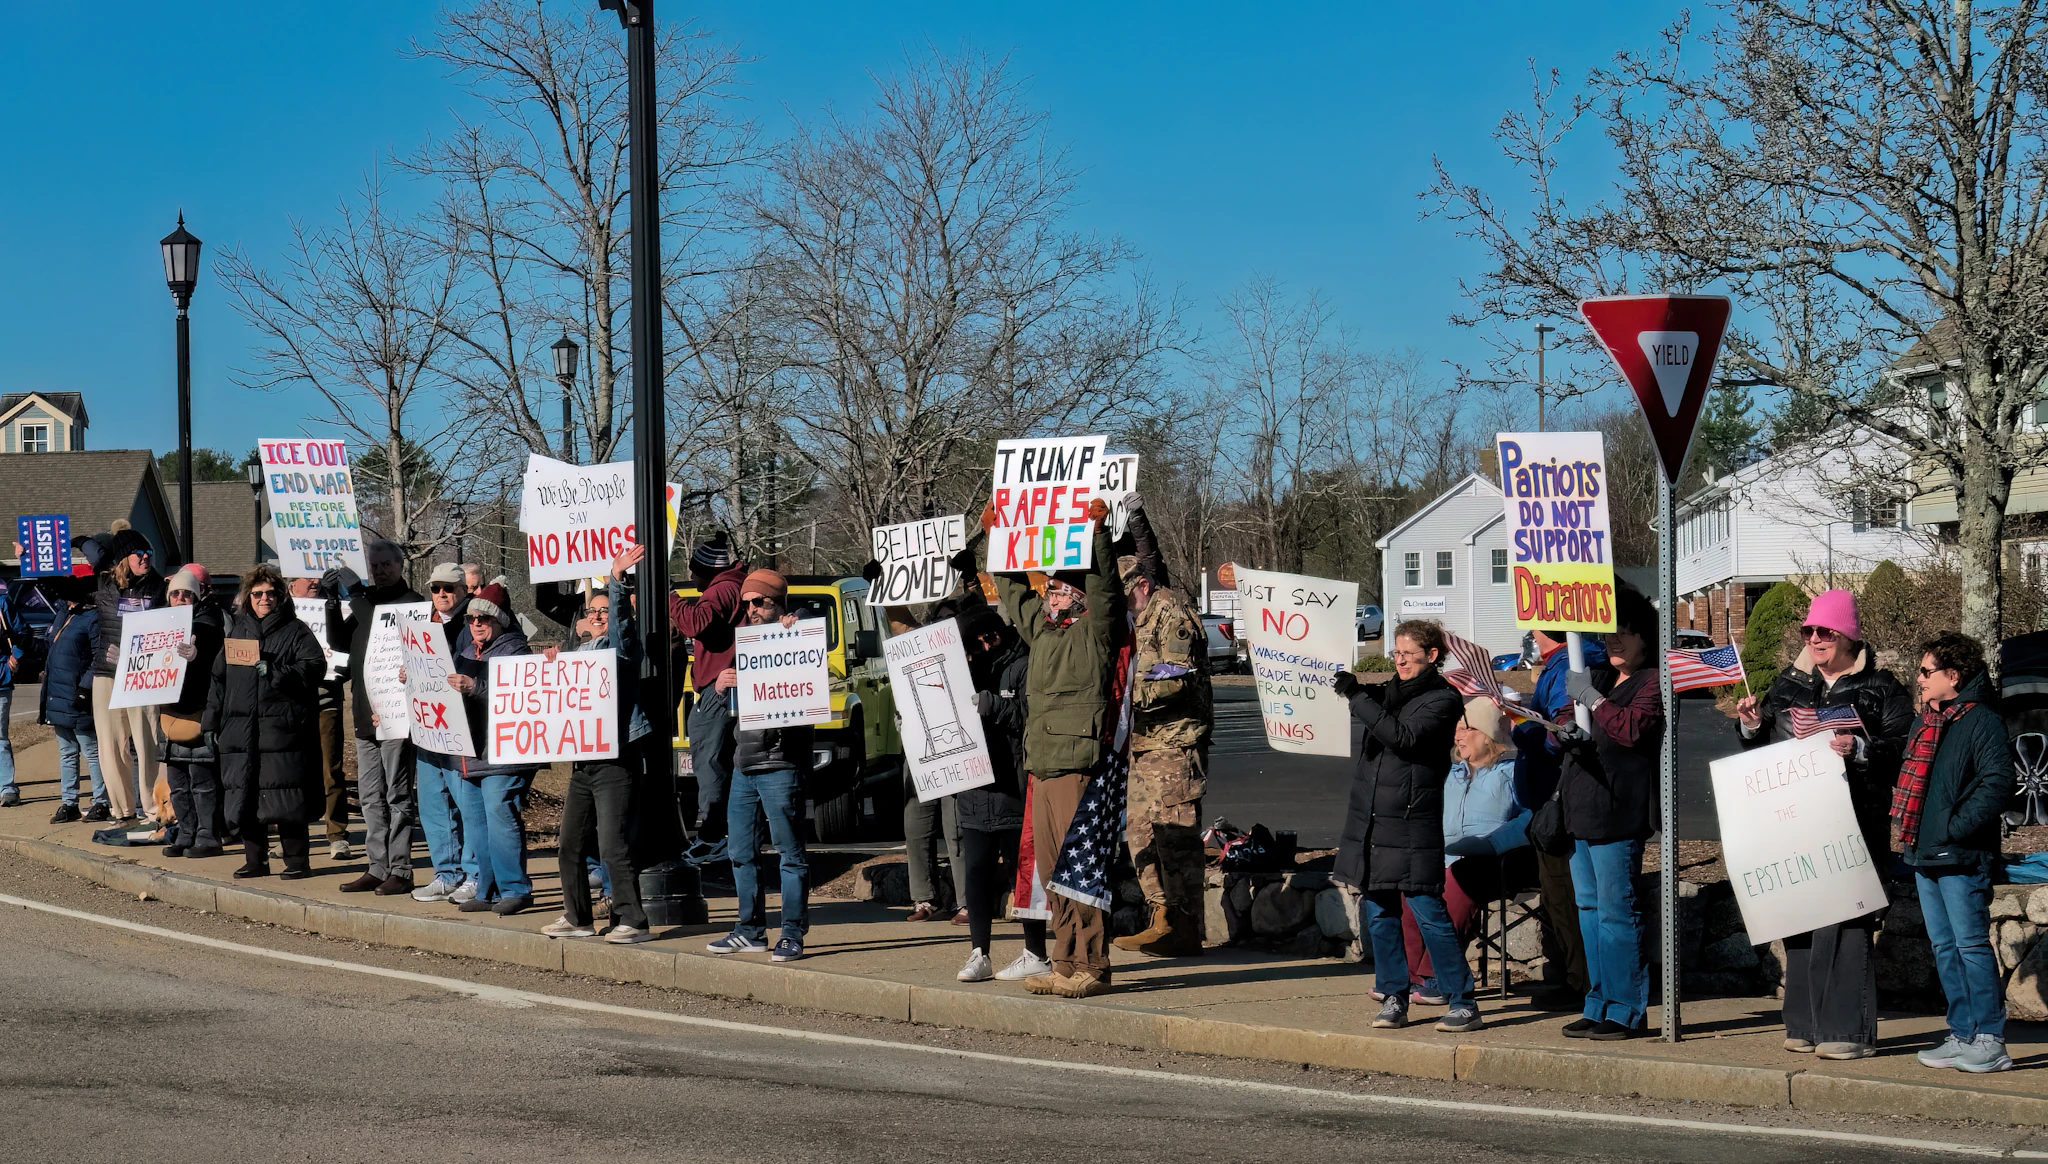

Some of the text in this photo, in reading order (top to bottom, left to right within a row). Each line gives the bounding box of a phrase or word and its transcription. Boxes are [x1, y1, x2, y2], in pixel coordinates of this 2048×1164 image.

[1652, 344, 1689, 366] YIELD
[262, 442, 348, 466] ICE OUT
[997, 446, 1096, 484] TRUMP
[270, 472, 352, 495] END WAR
[536, 474, 627, 509] We the People
[275, 512, 314, 529] RULE
[326, 512, 359, 530] LAW
[290, 502, 346, 512] RESTORE
[569, 511, 588, 525] SAY
[995, 485, 1091, 529] RAPES
[1519, 500, 1595, 529] DO NOT
[35, 520, 54, 571] RESIST!
[290, 538, 359, 552] NO MORE
[528, 524, 636, 568] NO KINGS
[876, 519, 961, 564] BELIEVE
[1005, 525, 1087, 570] KIDS
[1514, 528, 1604, 563] SUPPORT
[870, 555, 960, 604] WOMEN
[1238, 579, 1276, 603] JUST
[1291, 588, 1339, 609] SAY
[399, 622, 436, 655] WAR
[1262, 608, 1310, 641] NO
[130, 627, 185, 655] FREEDOM
[885, 626, 957, 664] HANDLE KINGS
[127, 653, 153, 672] NOT
[738, 648, 824, 671] Democracy
[123, 668, 179, 692] FASCISM
[497, 660, 611, 699] LIBERTY &
[1255, 662, 1338, 688] TRADE WARS
[494, 686, 592, 715] JUSTICE
[753, 681, 814, 701] Matters
[1258, 680, 1317, 700] FRAUD
[413, 697, 449, 729] SEX
[1262, 699, 1294, 716] LIES
[412, 723, 464, 752] CRIMES
[496, 718, 611, 757] FOR ALL
[1265, 718, 1315, 740] KINGS
[915, 769, 944, 792] LIKE
[939, 763, 964, 784] THE
[1744, 750, 1827, 796] RELEASE
[1774, 804, 1798, 823] THE
